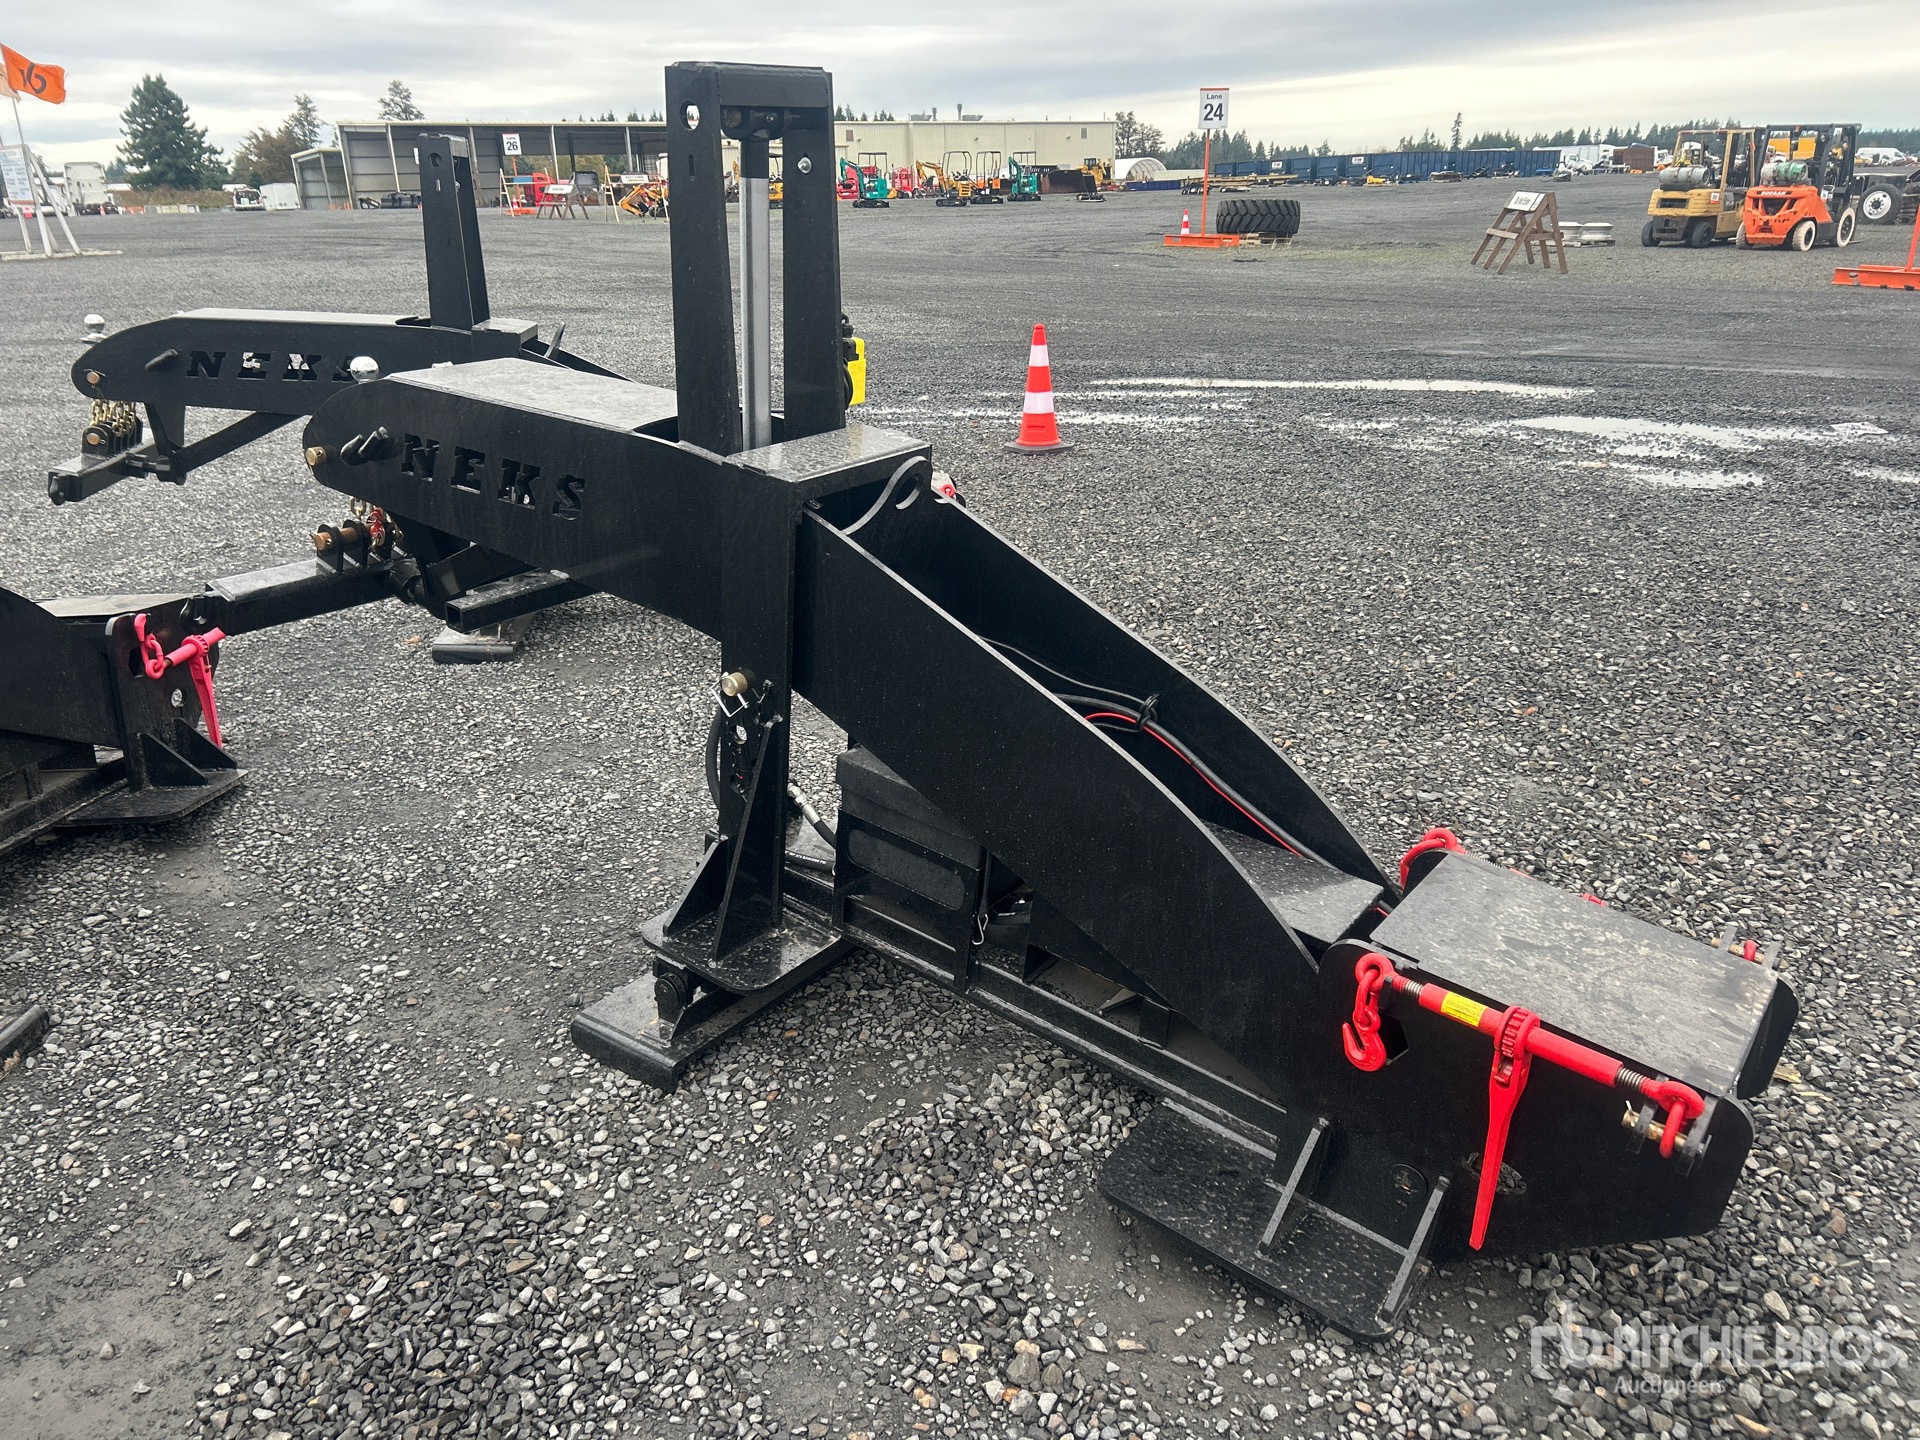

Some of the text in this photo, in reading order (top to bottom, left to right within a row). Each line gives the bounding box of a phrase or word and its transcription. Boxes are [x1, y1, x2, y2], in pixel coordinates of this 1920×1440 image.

[1203, 102, 1224, 121] 24
[506, 141, 519, 151] 26
[401, 433, 586, 521] NEKS
